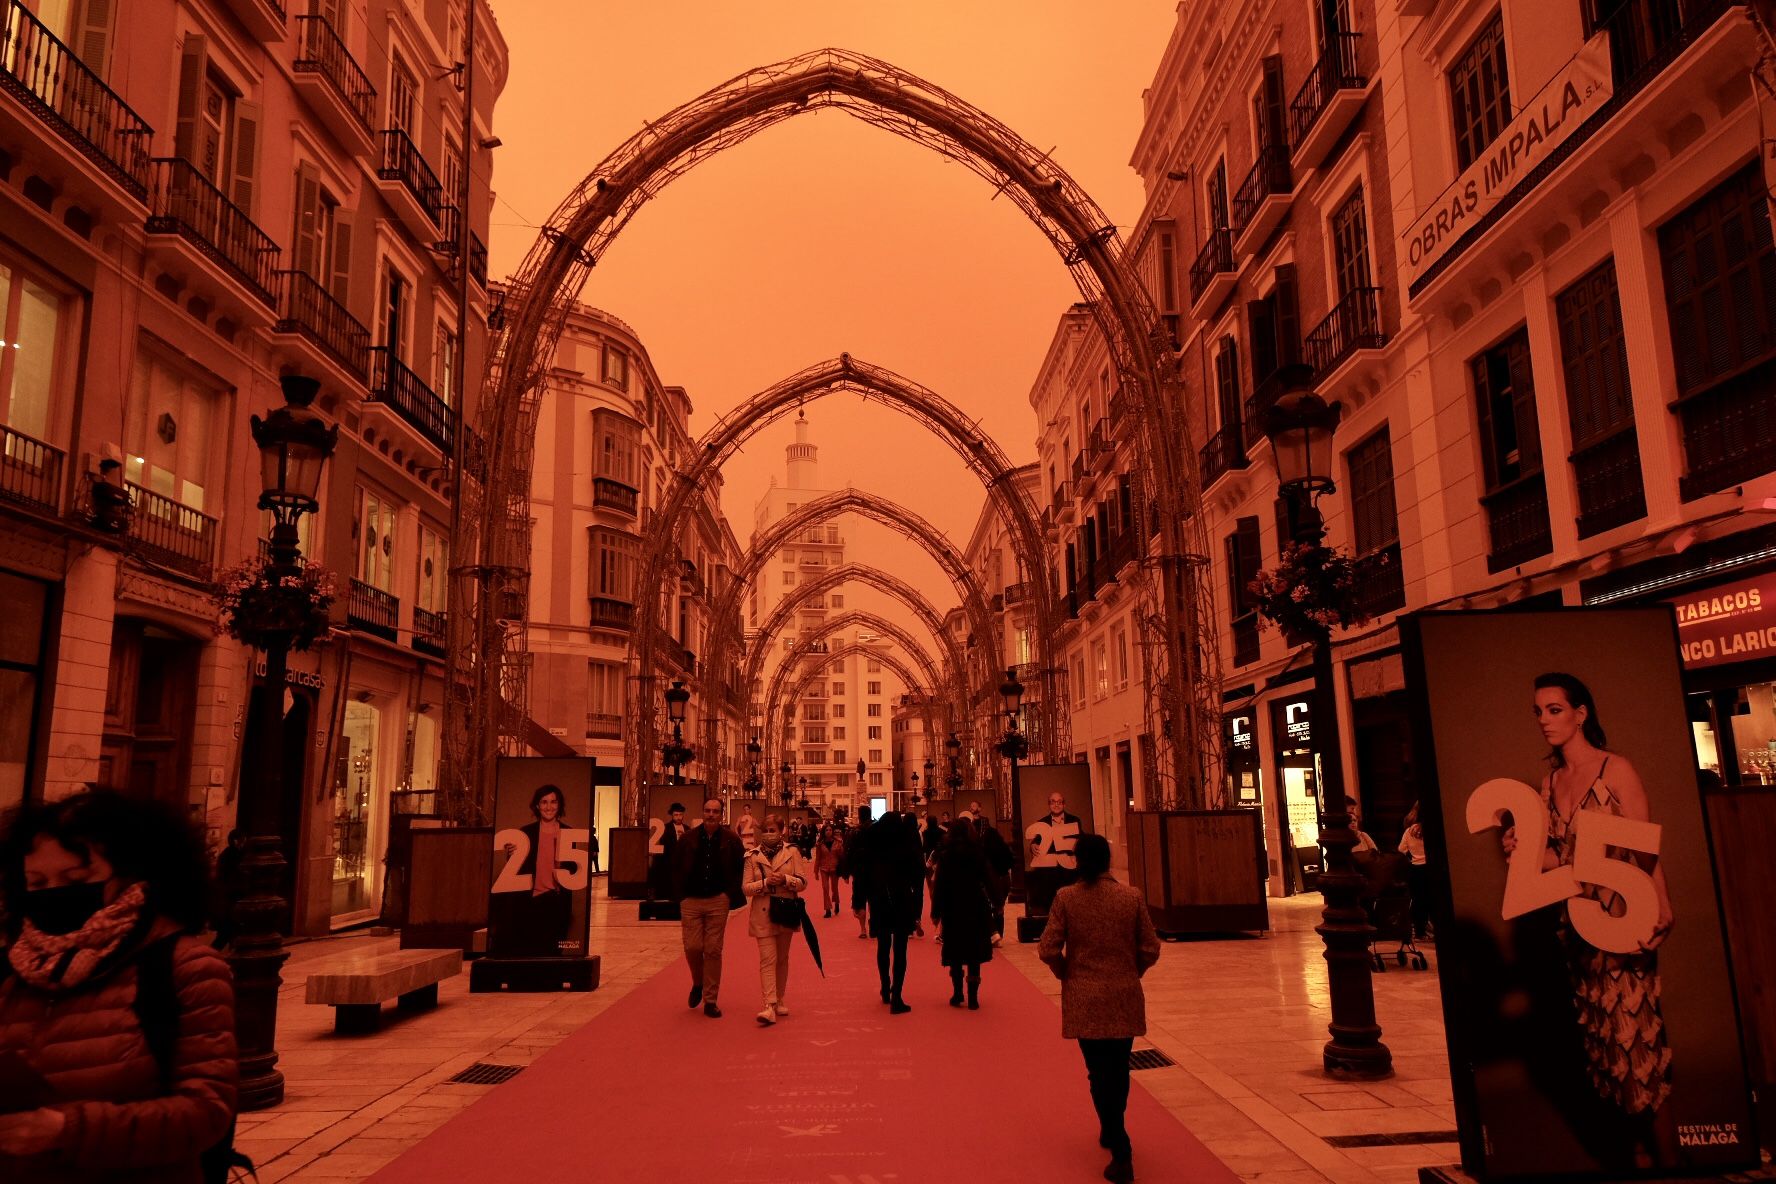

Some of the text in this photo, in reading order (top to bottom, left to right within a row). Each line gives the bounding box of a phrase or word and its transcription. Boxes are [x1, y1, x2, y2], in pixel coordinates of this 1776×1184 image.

[1408, 179, 1479, 267] OBRAS
[1676, 588, 1762, 621] TABACOS
[490, 828, 590, 894] 25
[1025, 821, 1080, 869] 25
[1465, 777, 1662, 954] 25
[1677, 1123, 1737, 1134] FESTIVAL DE
